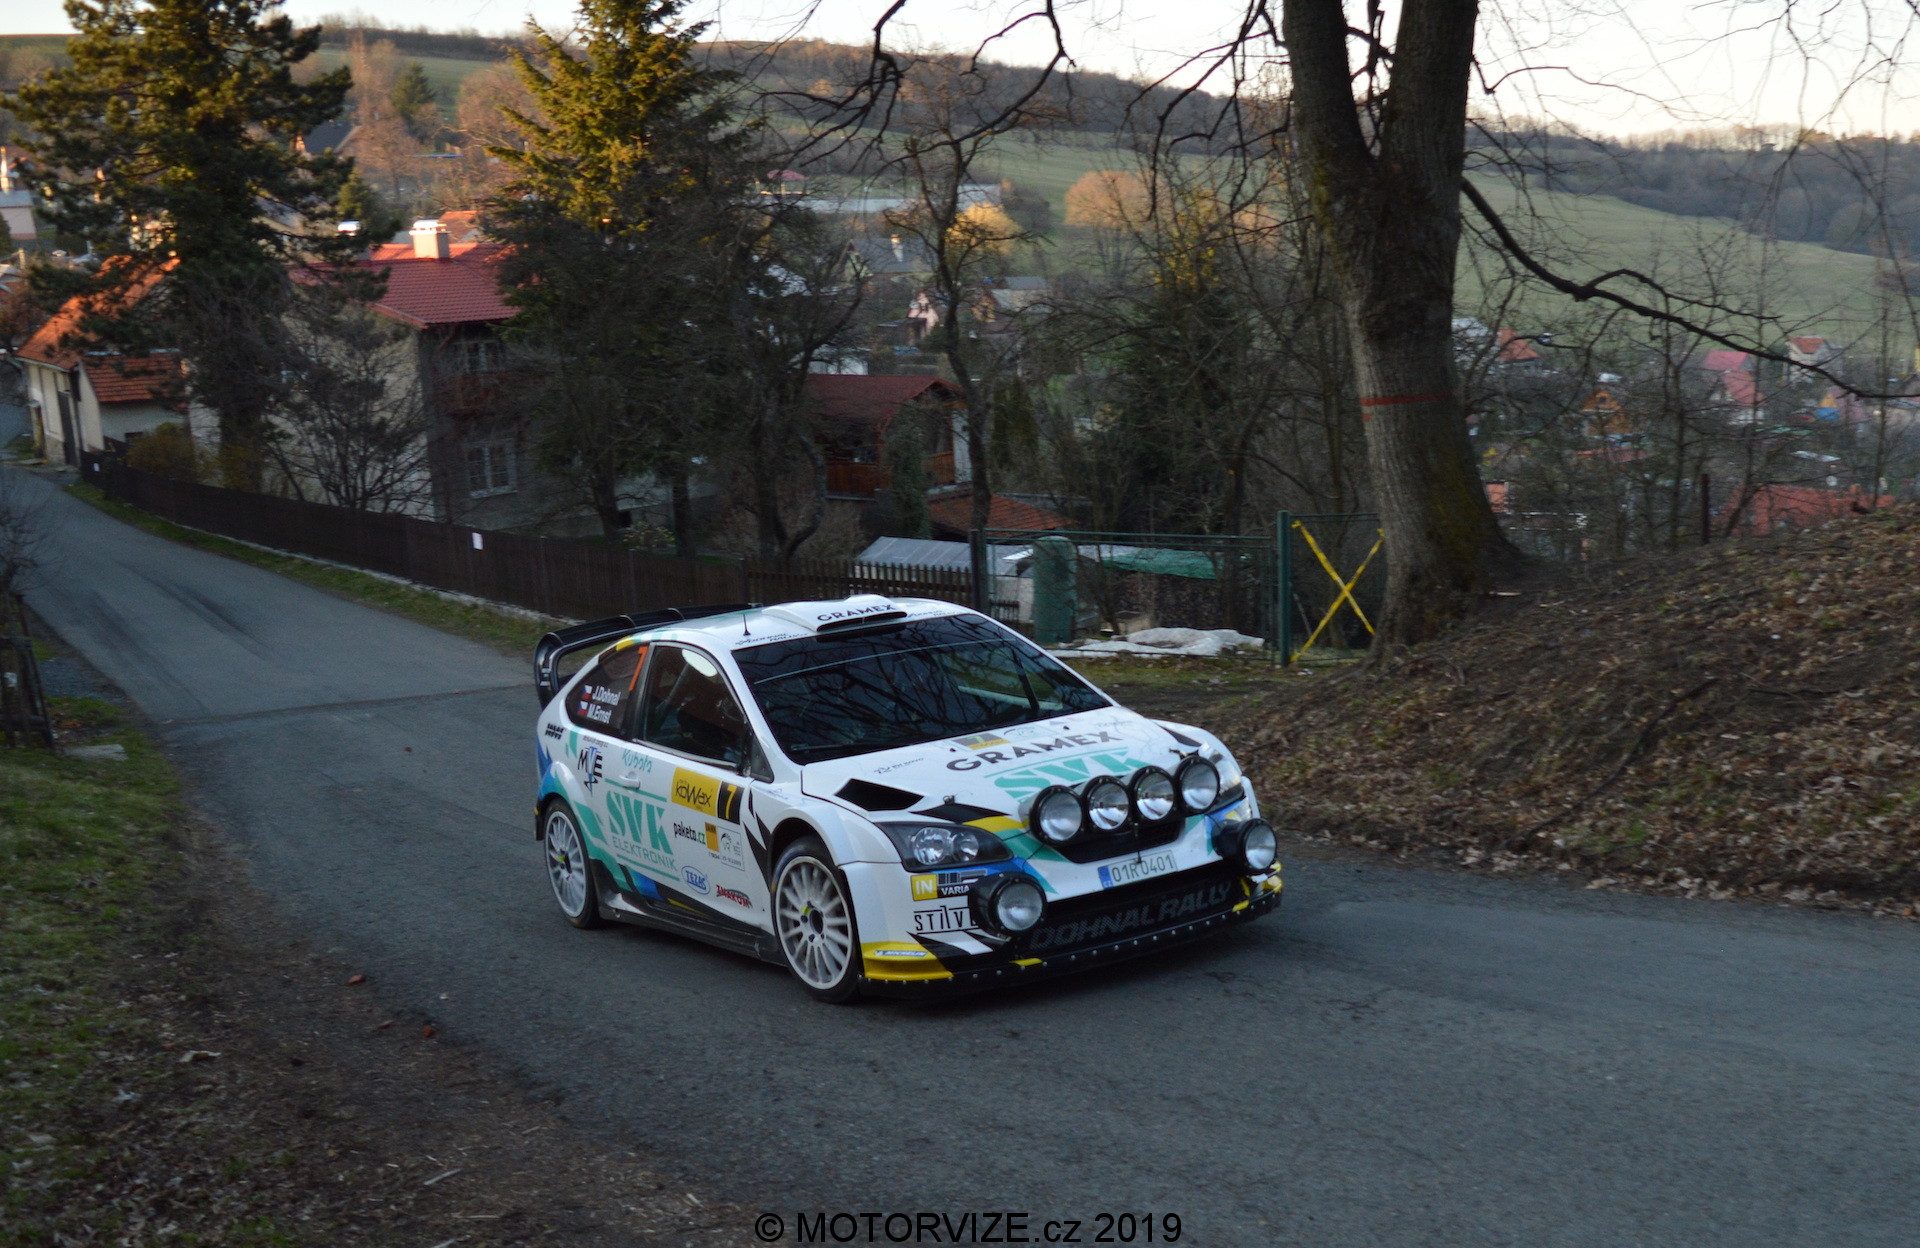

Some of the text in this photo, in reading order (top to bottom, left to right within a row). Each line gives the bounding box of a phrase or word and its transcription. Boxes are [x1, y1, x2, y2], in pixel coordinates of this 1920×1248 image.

[817, 604, 897, 622] GRAMEX
[946, 731, 1124, 771] GRAMEX
[725, 784, 738, 820] 7
[606, 790, 674, 855] SVK
[612, 836, 678, 872] ELEKTRONIK
[1030, 881, 1232, 949] DOHNAL RALLY
